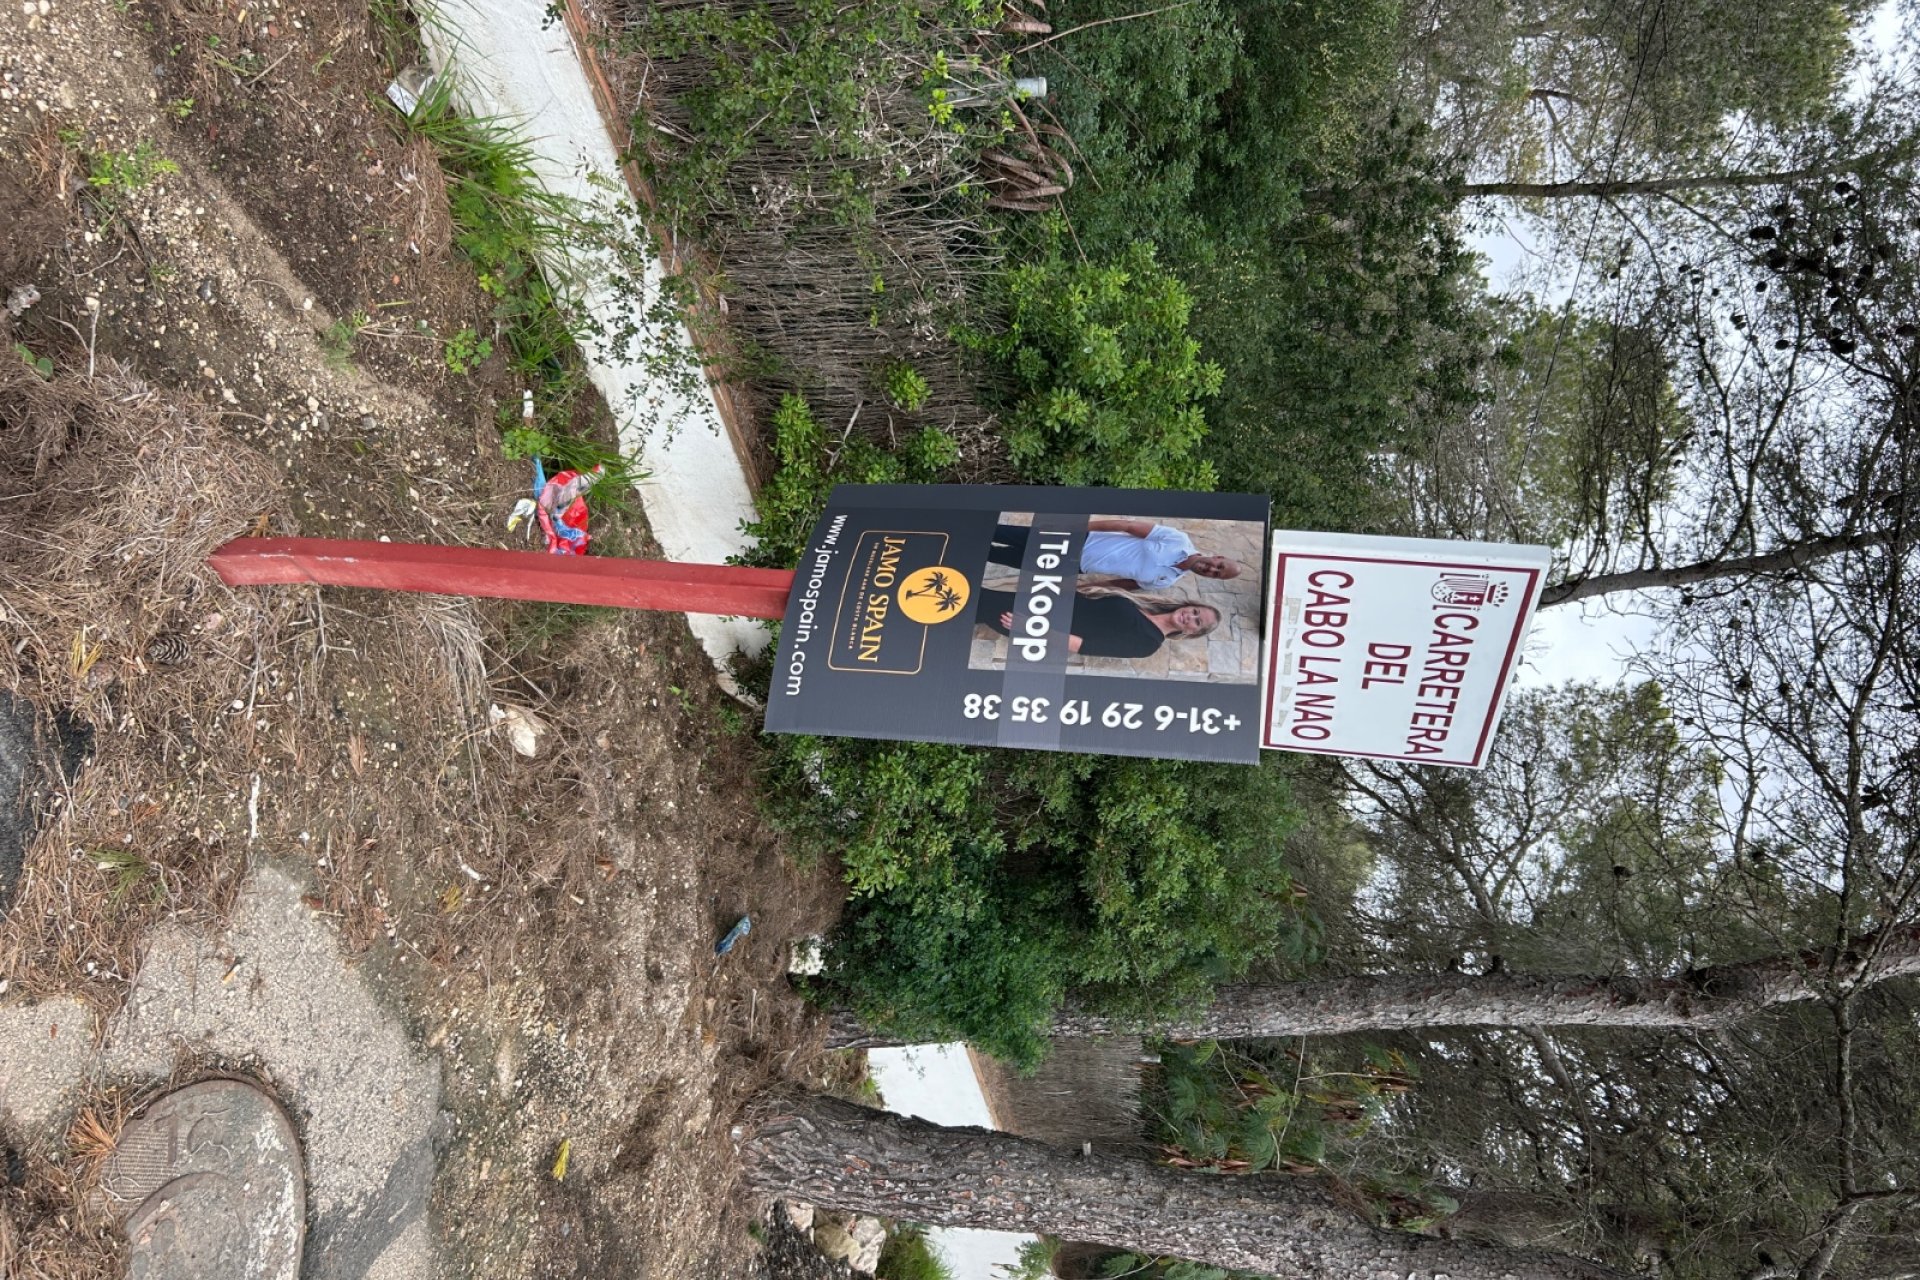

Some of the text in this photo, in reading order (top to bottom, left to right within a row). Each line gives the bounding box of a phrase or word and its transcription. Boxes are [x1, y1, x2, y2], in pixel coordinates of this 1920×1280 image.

[786, 514, 848, 695] www.jamospain.com
[858, 537, 906, 662] JAMO SPAIN
[1013, 540, 1069, 662] Te Koop
[1291, 570, 1354, 740] CABO LA NAO
[964, 693, 1241, 734] +31-6 29 19 35 38
[1361, 642, 1412, 690] DEL
[1404, 614, 1479, 755] CARRETERA
